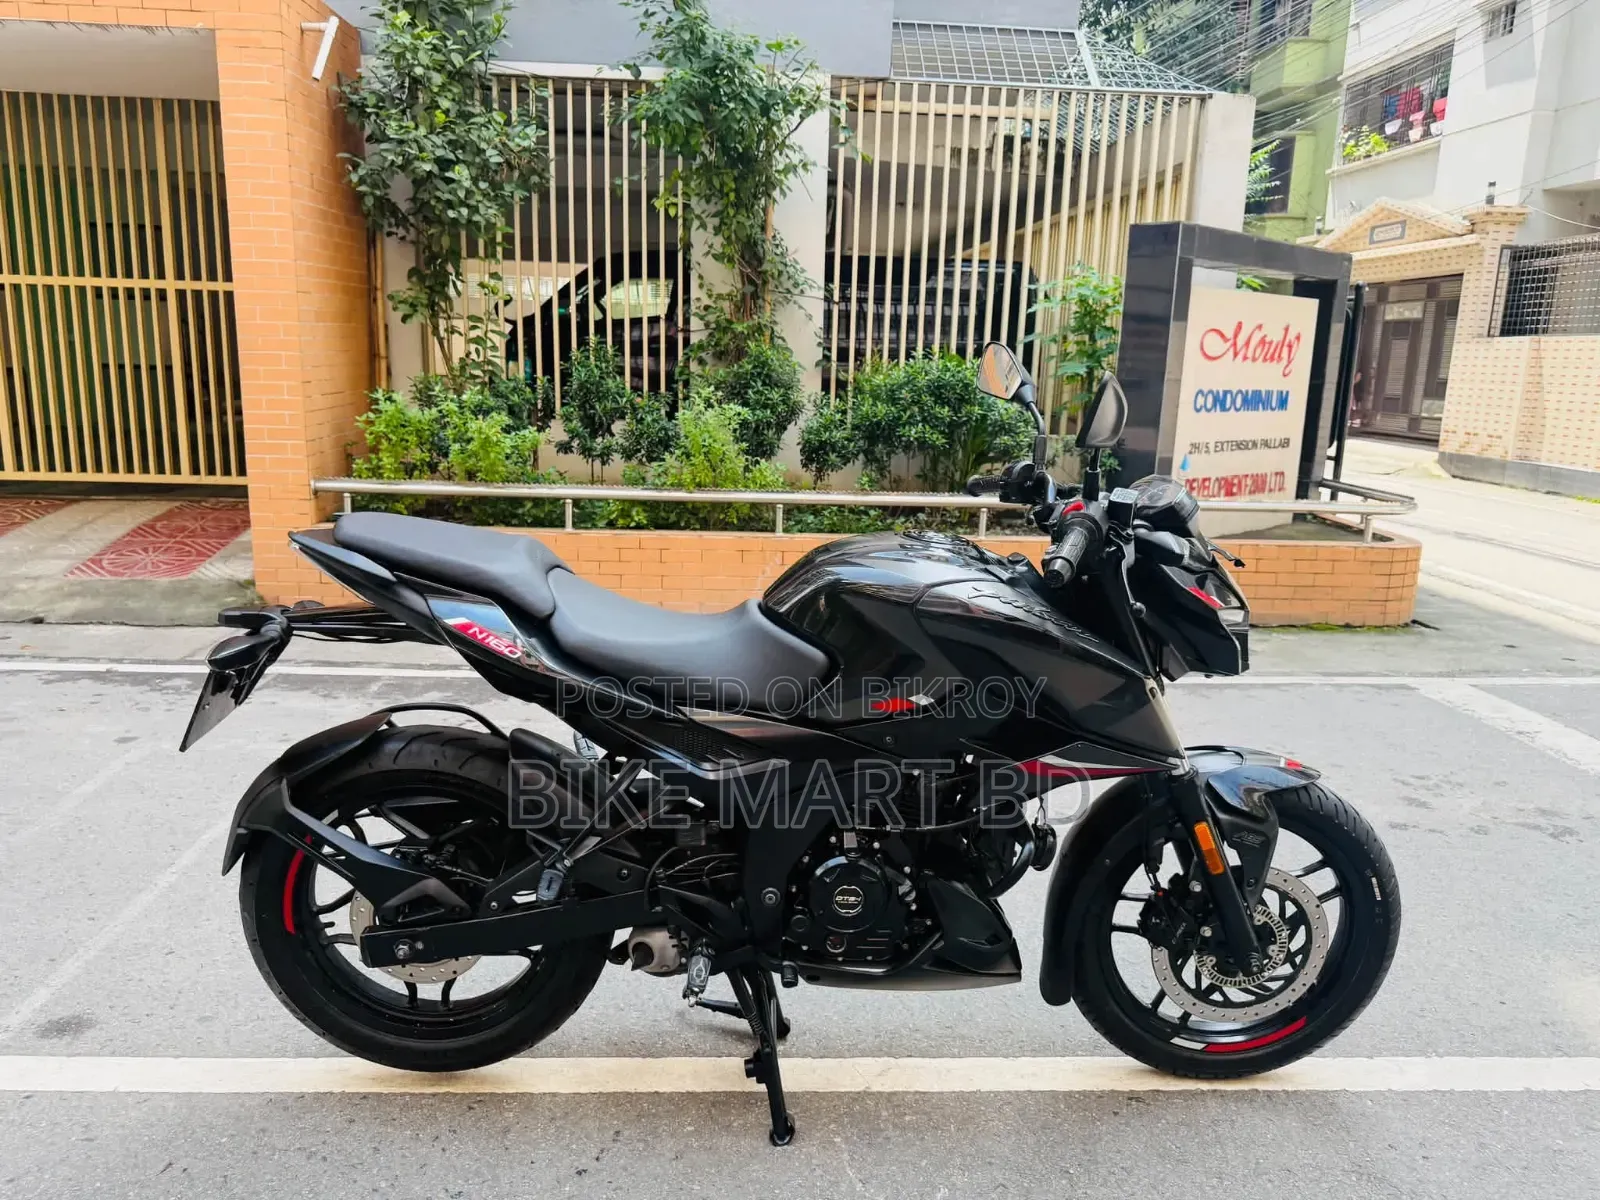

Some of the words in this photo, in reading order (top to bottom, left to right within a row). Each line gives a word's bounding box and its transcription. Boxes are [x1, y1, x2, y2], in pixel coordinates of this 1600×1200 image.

[1200, 321, 1302, 378] Mouly
[1194, 389, 1290, 413] CONDOMINIUM
[1214, 438, 1259, 453] EXTENSION
[1259, 437, 1291, 450] PALLABI
[468, 627, 522, 659] N160
